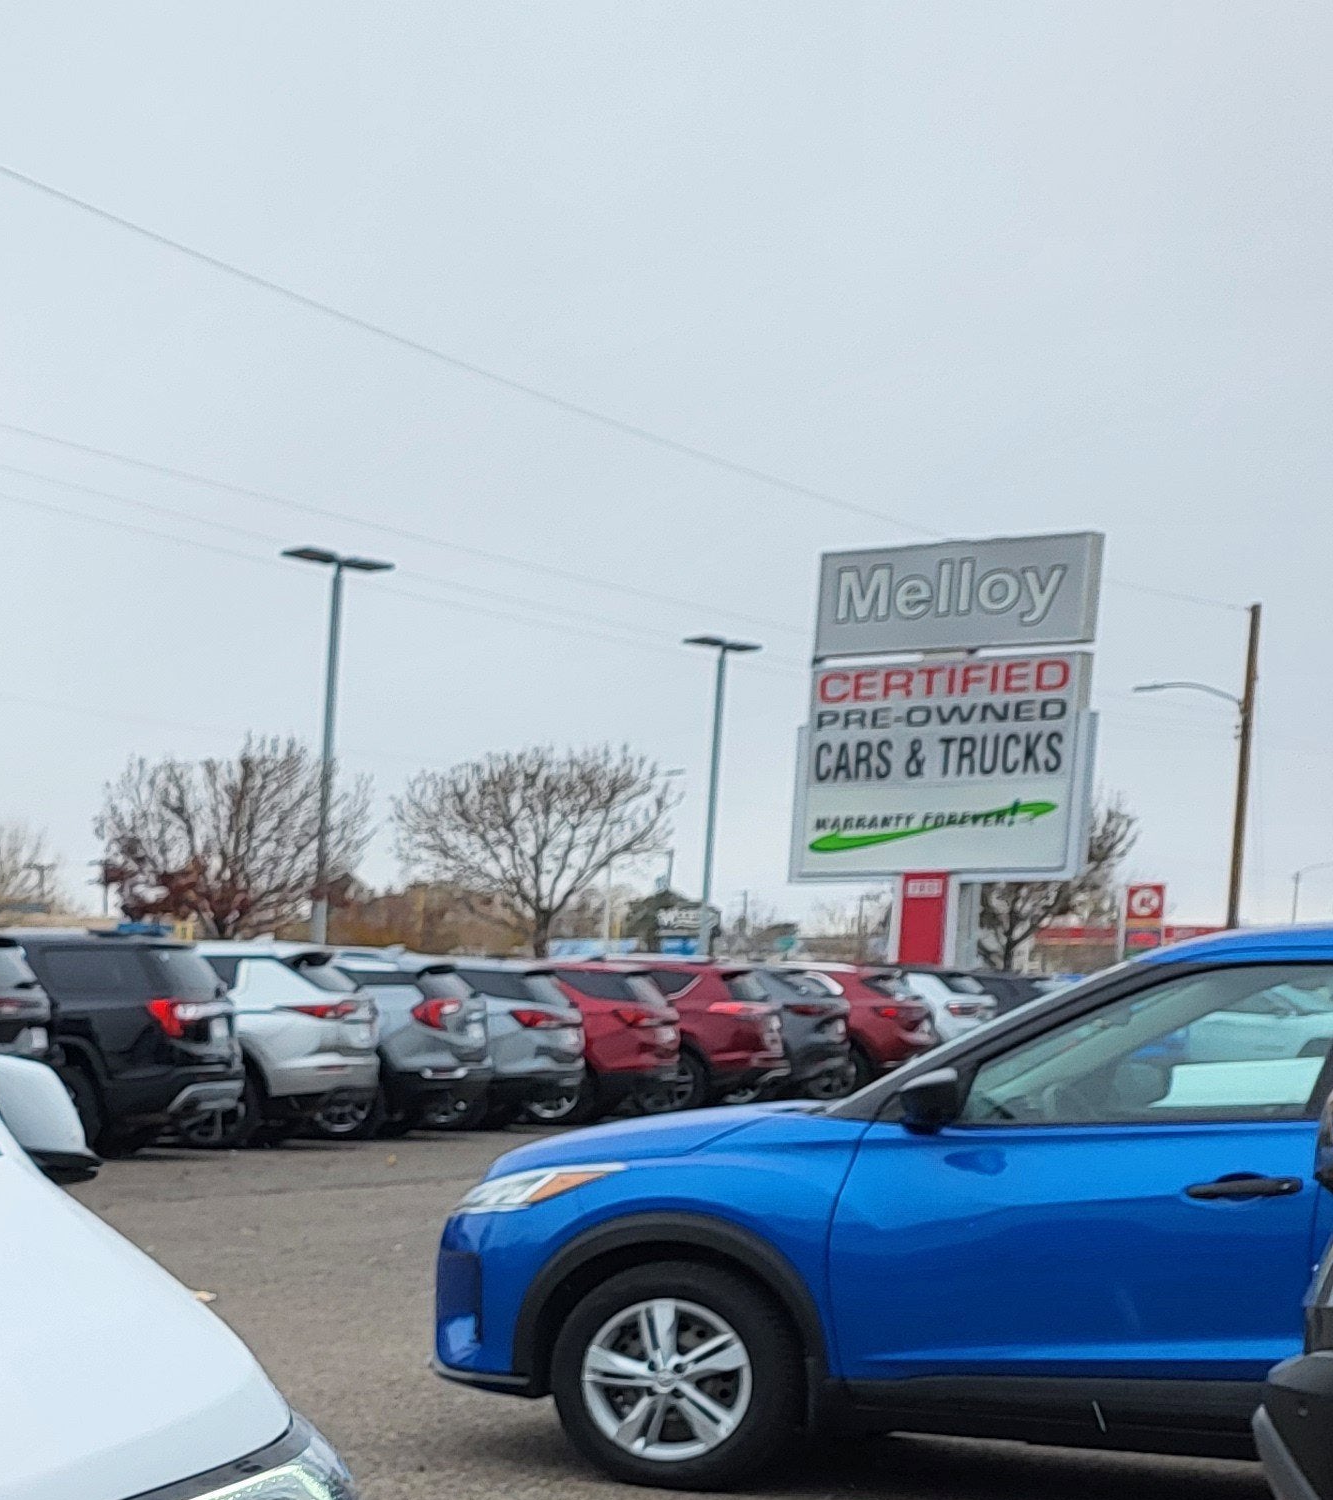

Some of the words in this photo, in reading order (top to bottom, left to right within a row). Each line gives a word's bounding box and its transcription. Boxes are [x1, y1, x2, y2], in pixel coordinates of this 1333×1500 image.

[834, 556, 1069, 627] Melloy
[817, 658, 1072, 705] CERTIFIED
[817, 699, 1068, 732] PRE-OWNED
[814, 738, 894, 784] CARS
[904, 737, 927, 779] &
[938, 731, 1064, 777] TRUCKS
[816, 811, 915, 833] WARRANTY
